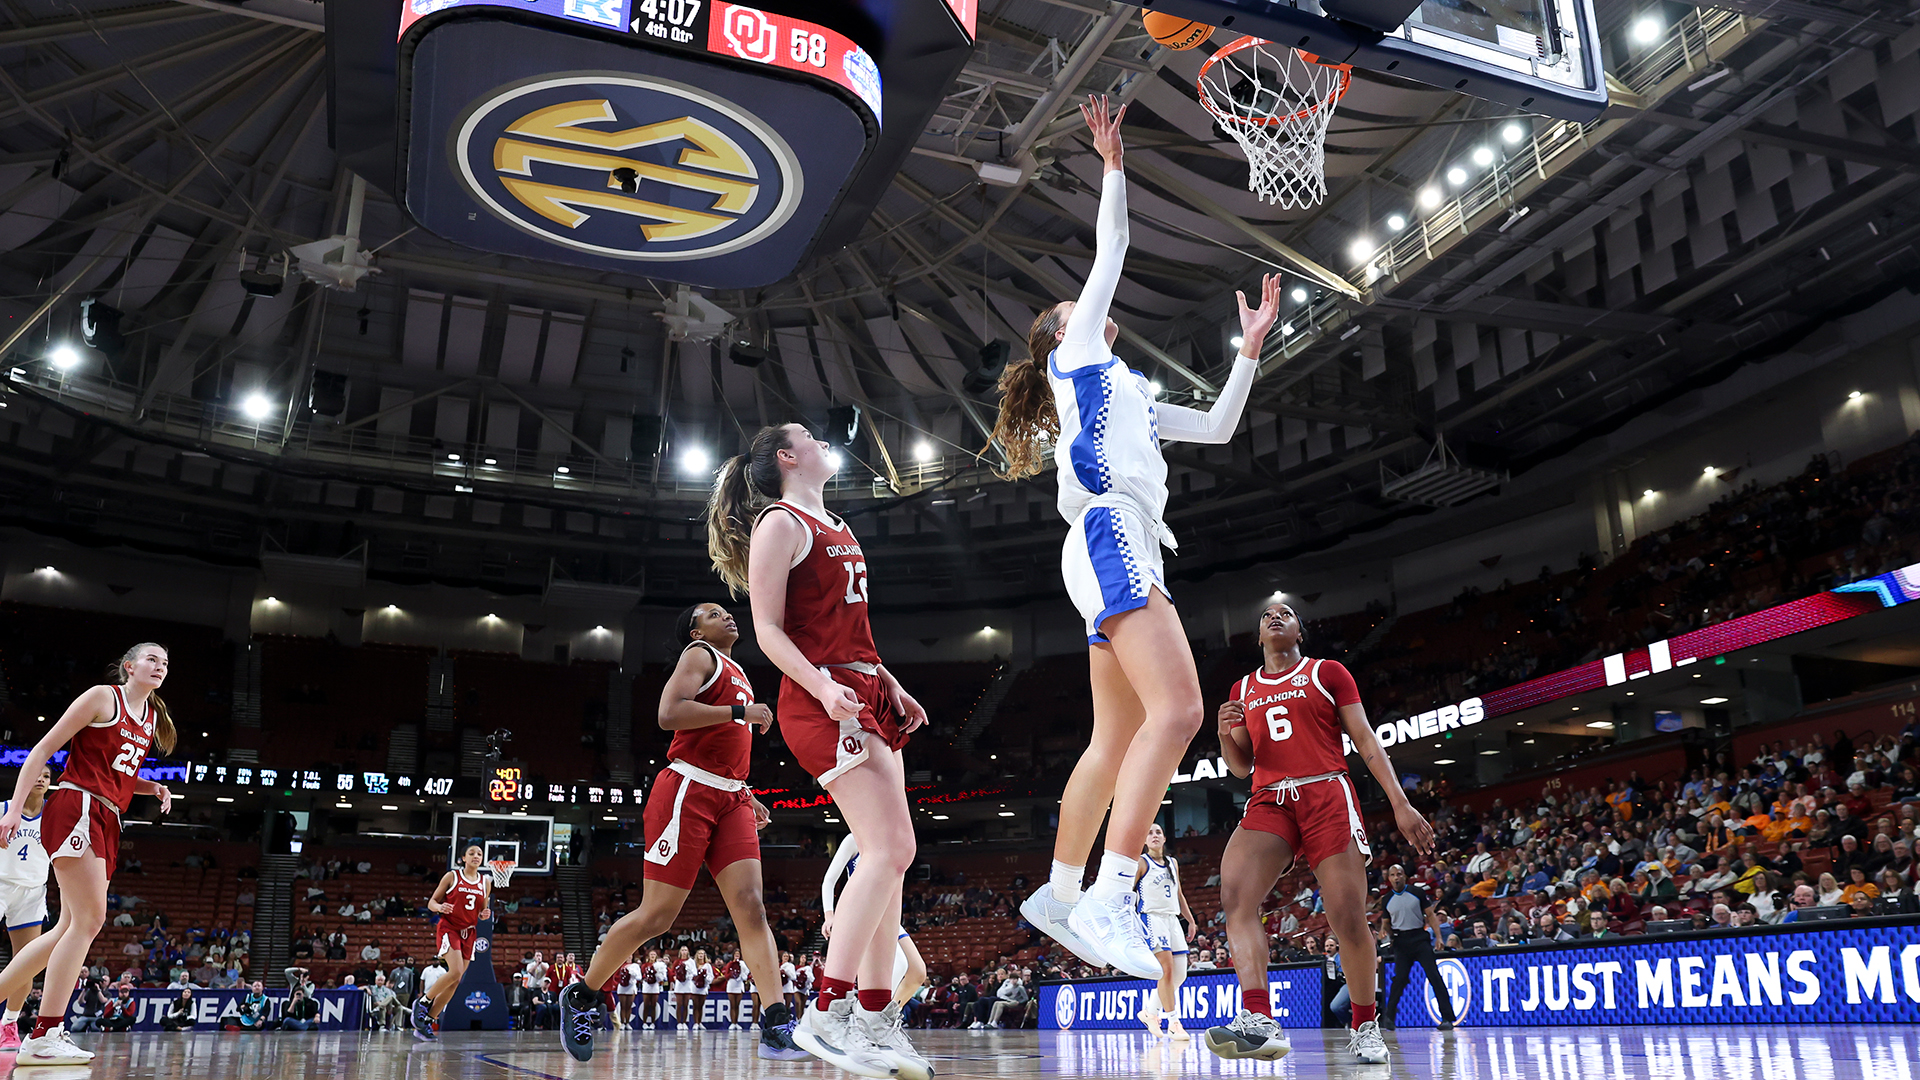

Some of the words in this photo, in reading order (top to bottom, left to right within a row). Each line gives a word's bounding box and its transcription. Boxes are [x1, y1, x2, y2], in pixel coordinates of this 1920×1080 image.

[641, 0, 701, 27] 4:07
[645, 21, 668, 39] 4th
[670, 28, 694, 44] Qtr
[791, 28, 826, 68] 58
[843, 561, 868, 604] 12
[1291, 675, 1309, 686] SEC
[1248, 689, 1307, 711] OKLAHOMA
[1891, 702, 1915, 717] 114
[1265, 705, 1293, 742] 6
[111, 742, 146, 778] 25
[292, 770, 298, 779] 4
[337, 774, 354, 790] 55
[398, 776, 411, 787] 4th
[496, 768, 521, 780] 4:07
[291, 780, 297, 789] 4
[302, 780, 320, 789] Fouls
[424, 778, 453, 795] 4:07
[548, 793, 564, 802] Fouls
[17, 844, 29, 860] 4
[120, 841, 134, 850] 20
[1164, 885, 1171, 898] 3
[464, 895, 477, 911] 3
[1482, 967, 1516, 1012] IT
[1521, 961, 1623, 1011] JUST
[1635, 950, 1821, 1009] MEANS
[1080, 992, 1095, 1020] IT
[1096, 990, 1138, 1020] JUST
